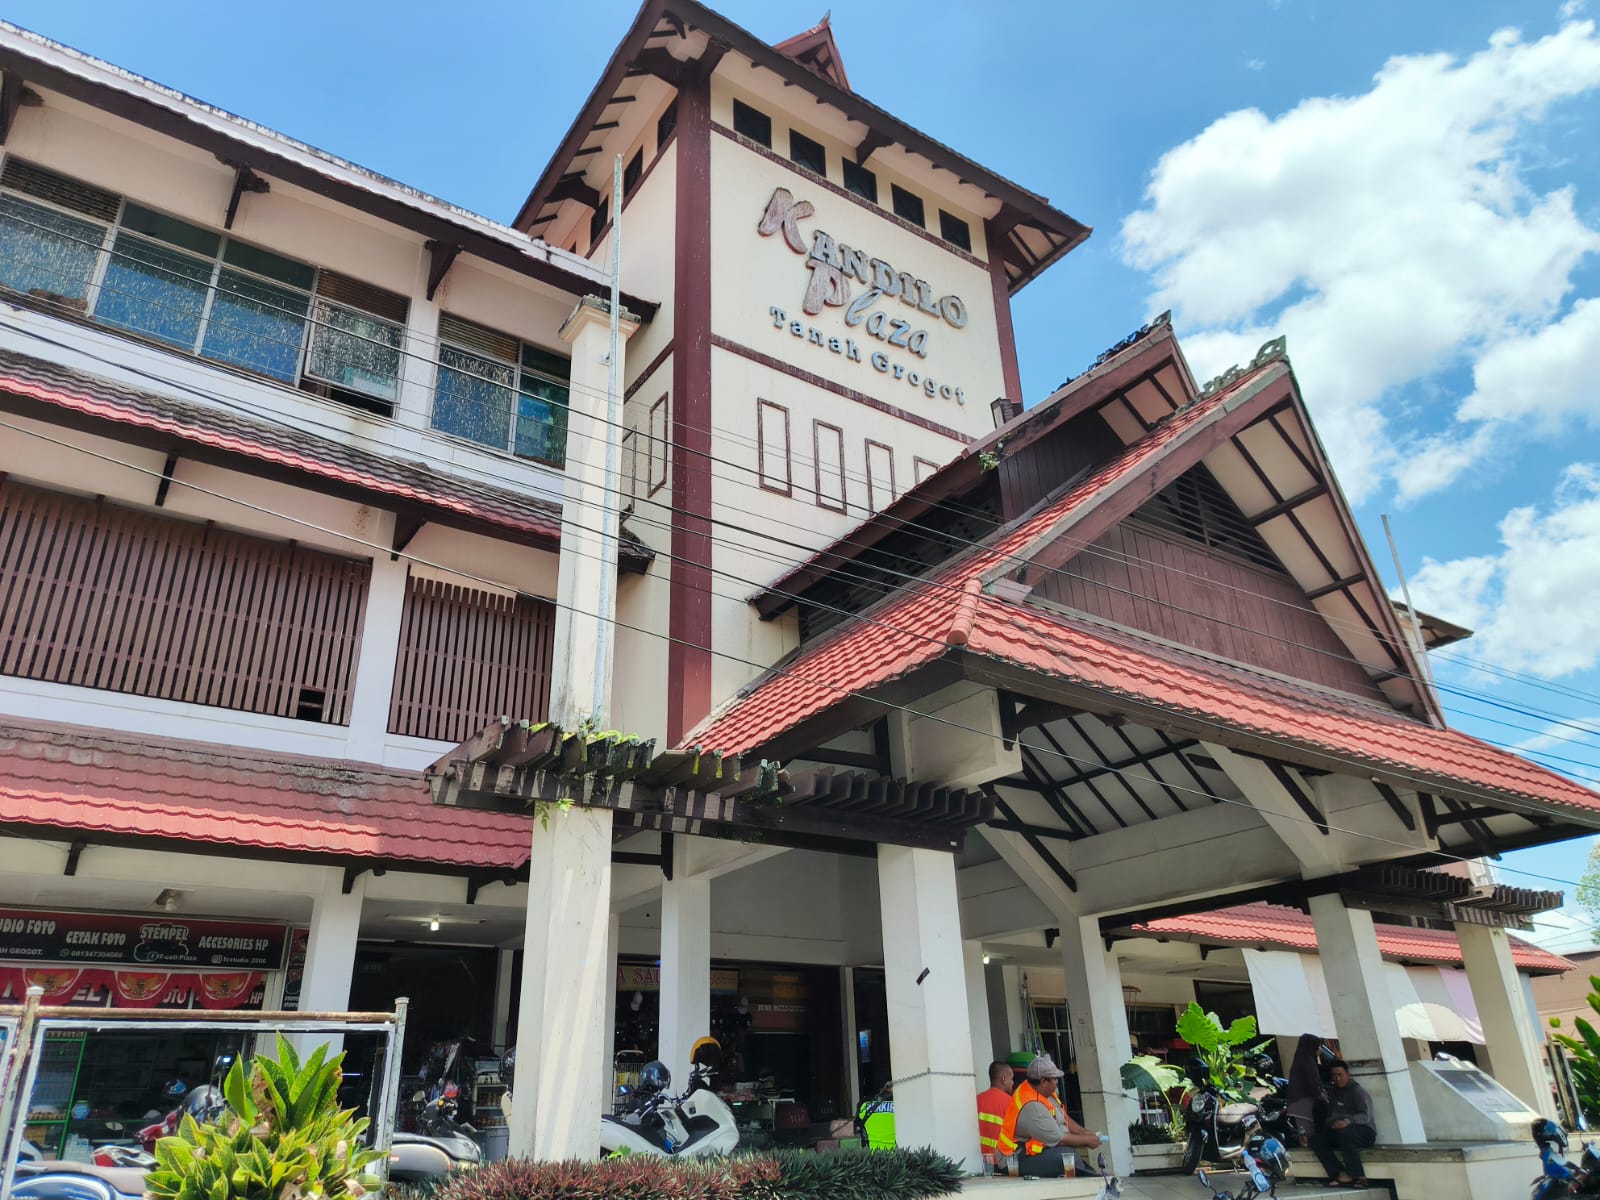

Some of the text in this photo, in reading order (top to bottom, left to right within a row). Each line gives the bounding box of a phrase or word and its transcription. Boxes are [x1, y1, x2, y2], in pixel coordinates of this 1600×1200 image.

[758, 187, 969, 328] KANDILO
[802, 259, 929, 358] Plaza
[770, 305, 966, 405] Tanah Grogot
[26, 920, 56, 935] FOTO
[140, 926, 188, 941] STEMPEL
[66, 931, 126, 945] CETAK FOTO
[198, 936, 269, 951] ACCESORIES HP
[249, 992, 263, 1005] HP
